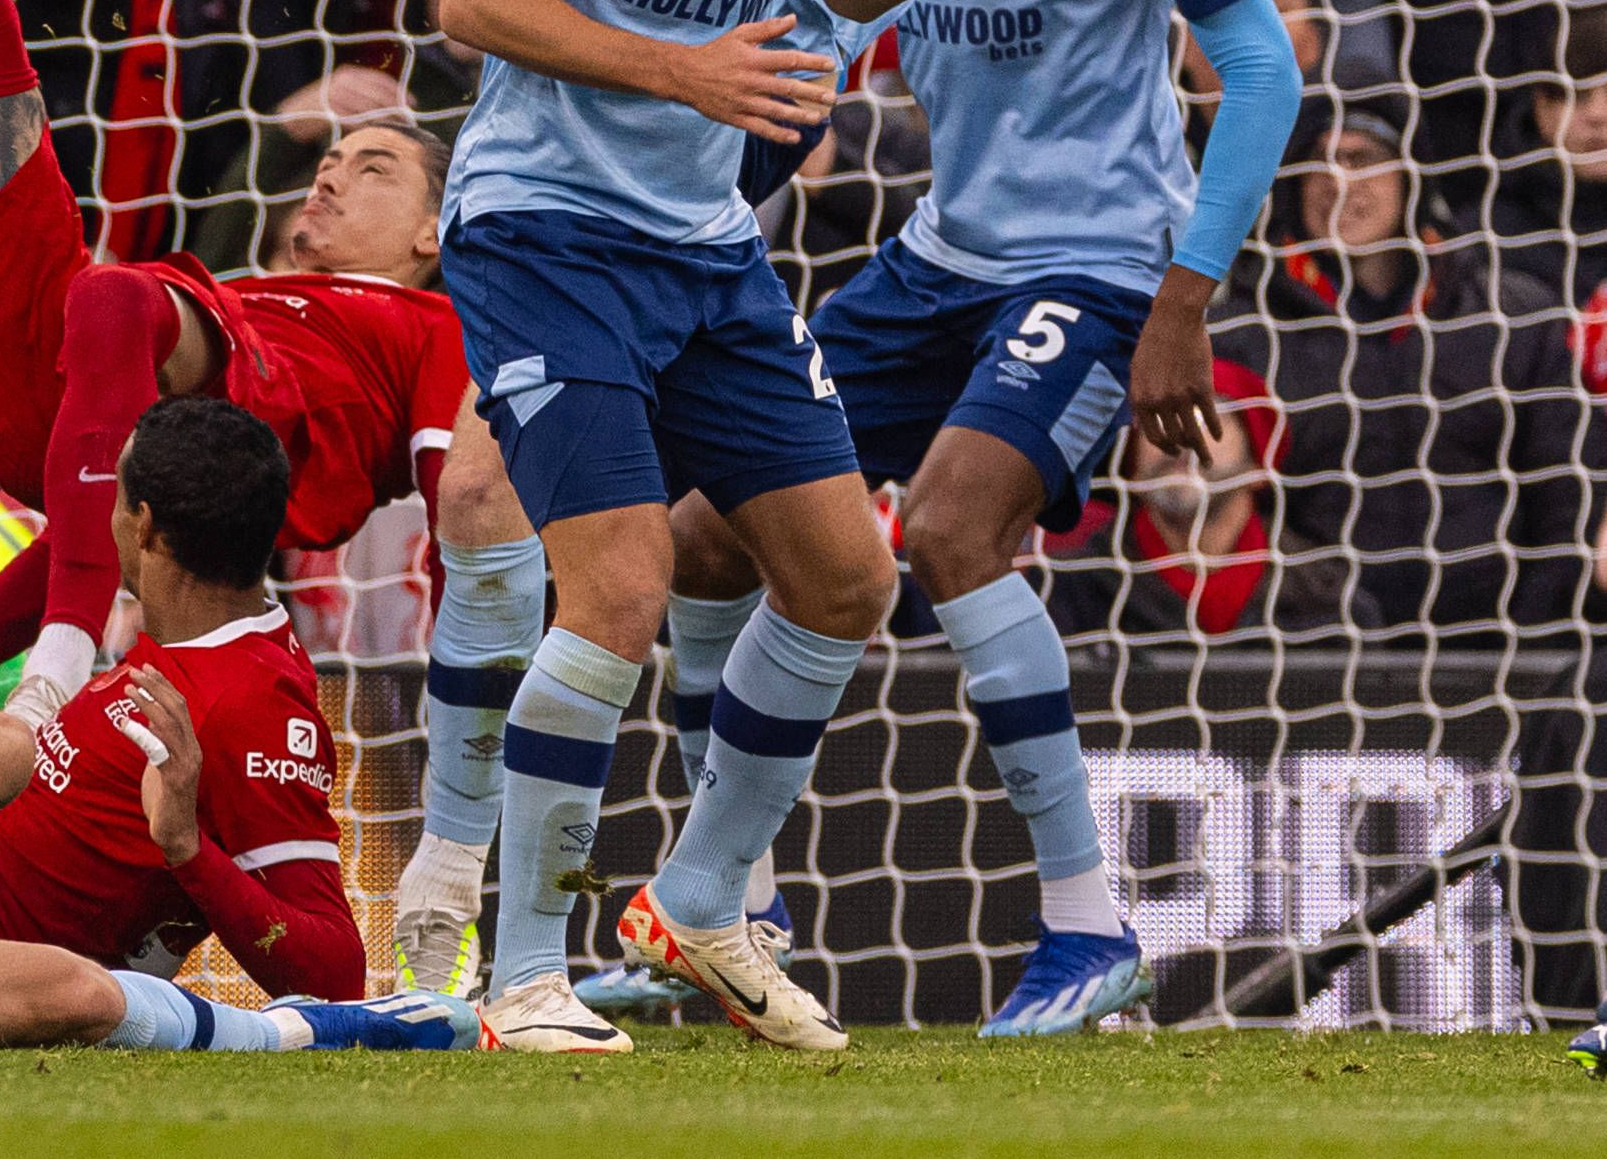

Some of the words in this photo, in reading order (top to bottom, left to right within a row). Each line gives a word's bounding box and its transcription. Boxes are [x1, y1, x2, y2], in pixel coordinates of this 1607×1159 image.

[896, 1, 1043, 46] LLYWOOD
[988, 40, 1043, 62] bets
[1006, 301, 1081, 363] 5
[246, 752, 333, 794] Expedia
